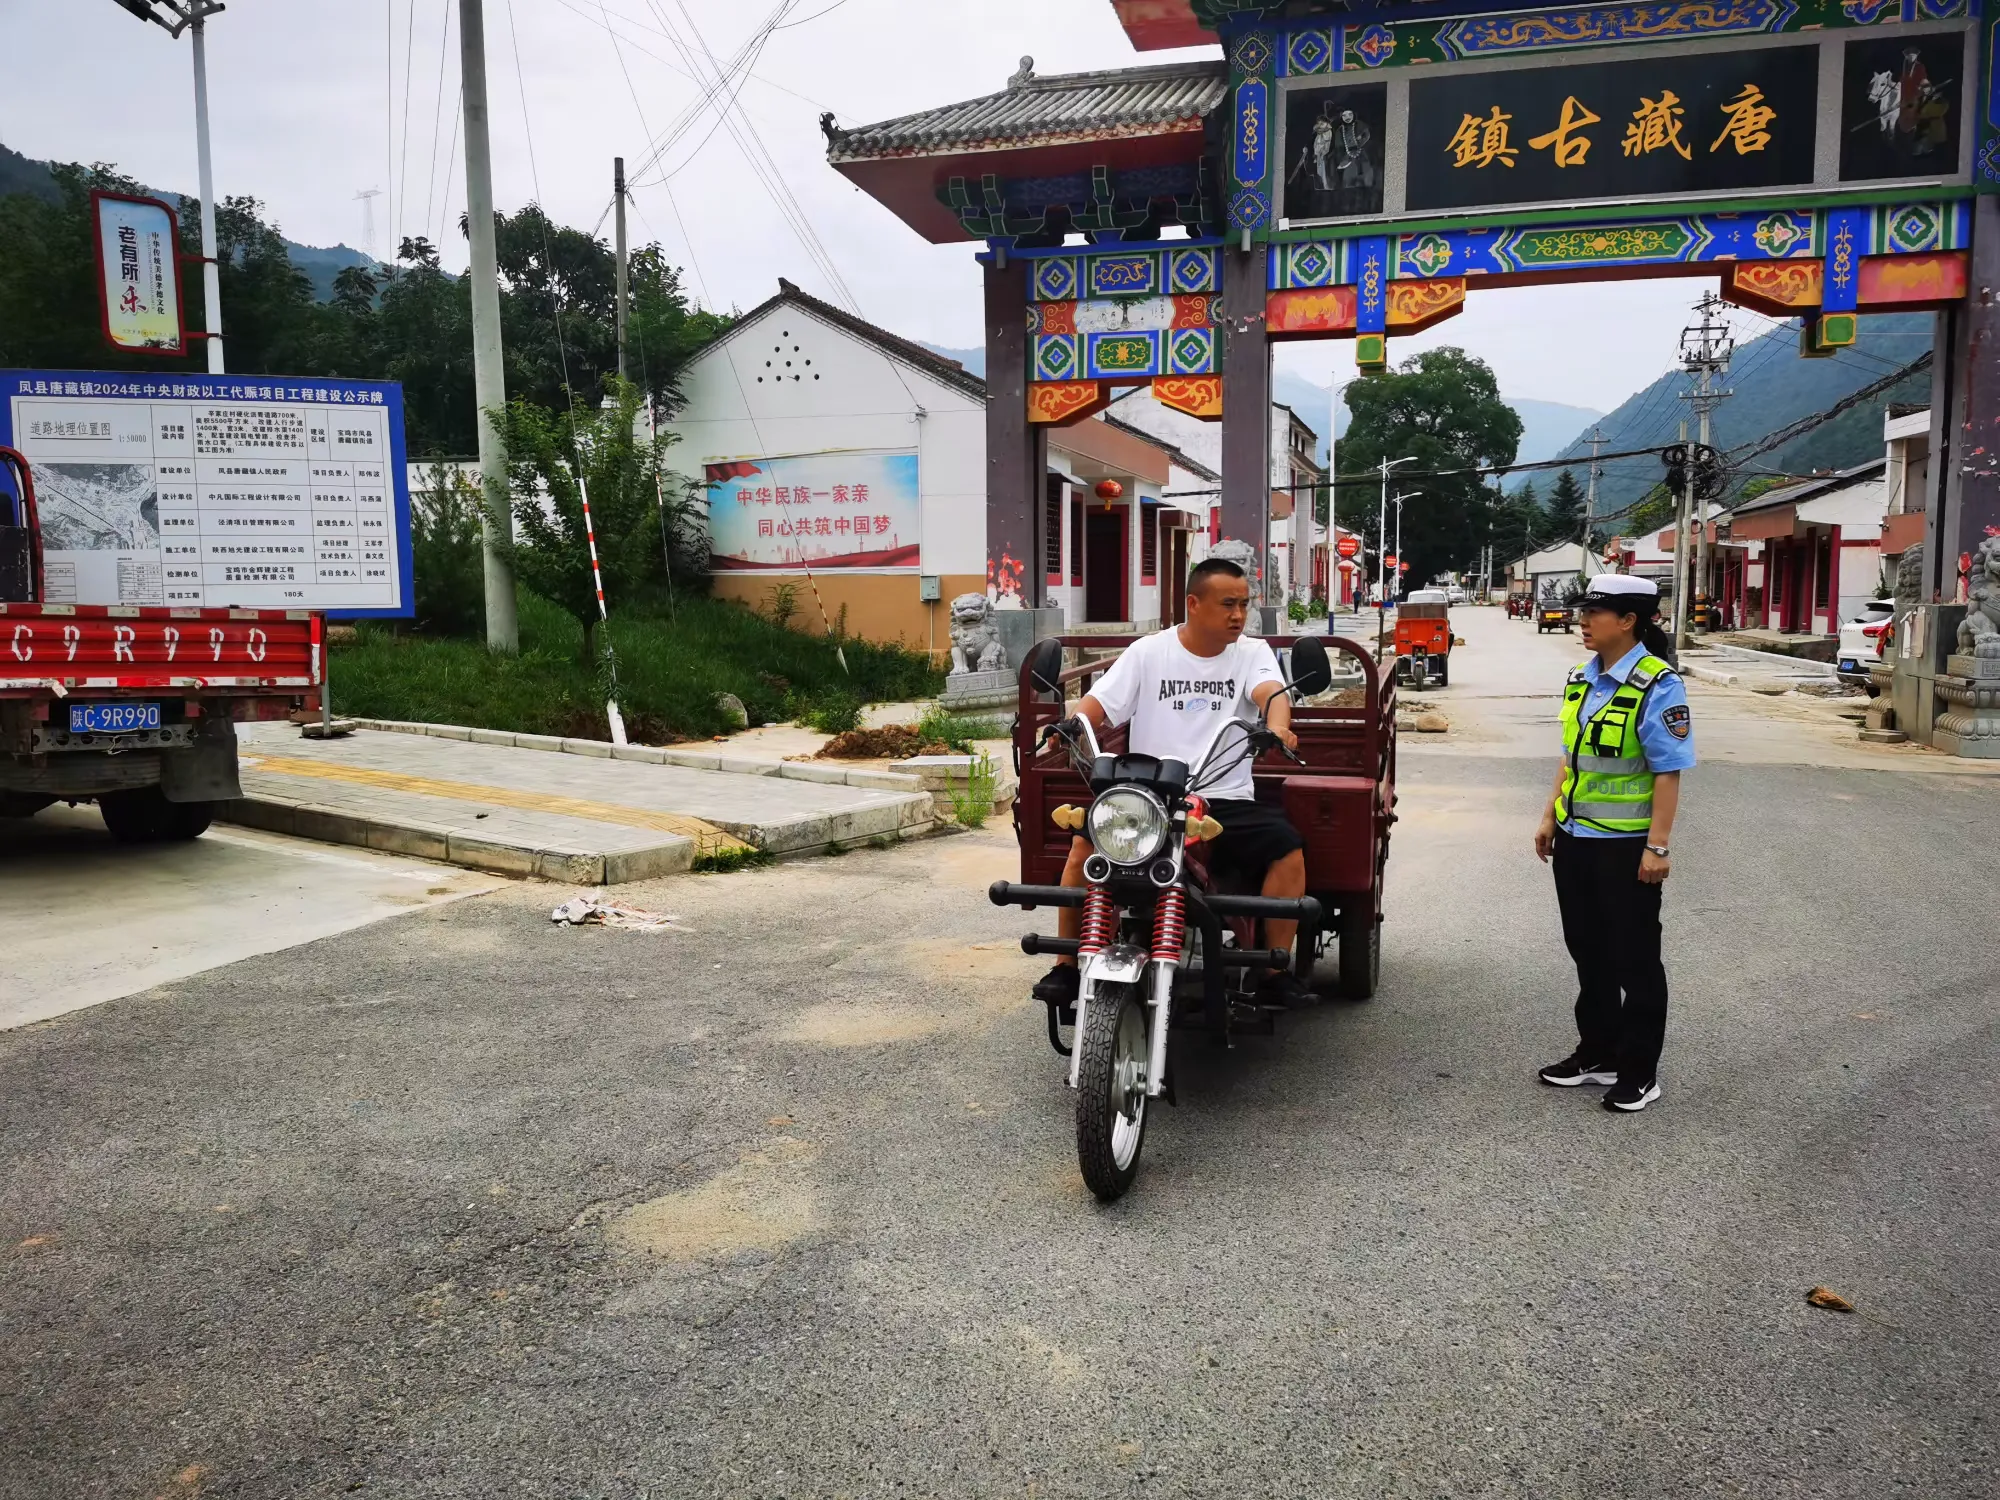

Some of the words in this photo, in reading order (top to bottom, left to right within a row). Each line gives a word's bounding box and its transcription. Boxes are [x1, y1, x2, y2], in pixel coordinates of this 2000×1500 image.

[117, 225, 148, 316] 老有所乐
[30, 420, 111, 436] 道路地理位置图
[161, 432, 184, 440] 设内容
[337, 429, 372, 437] 宝鸡市凤县
[218, 467, 287, 475] 凤县唐藏镇人民政府
[312, 469, 350, 477] 项目负责人
[162, 493, 193, 501] 设计单位
[208, 493, 301, 502] 中凡国际工程设计有限公司
[314, 494, 352, 502] 项目负责人
[736, 483, 870, 507] 中华民族一家亲
[163, 518, 195, 526] 监理单位
[316, 519, 354, 527] 监理负责人
[758, 513, 892, 538] 同心共筑中国梦
[165, 546, 197, 554] 施工单位
[320, 552, 354, 560] 技术负责人
[167, 570, 198, 578] 检测单位
[225, 573, 295, 581] 质量检测有限公司
[319, 569, 357, 577] 项目负责人
[168, 592, 200, 600] 项目工期
[1158, 679, 1192, 701] ANTA
[1193, 678, 1236, 699] SPORTS
[1172, 700, 1184, 710] 19
[1587, 780, 1649, 795] POLICE
